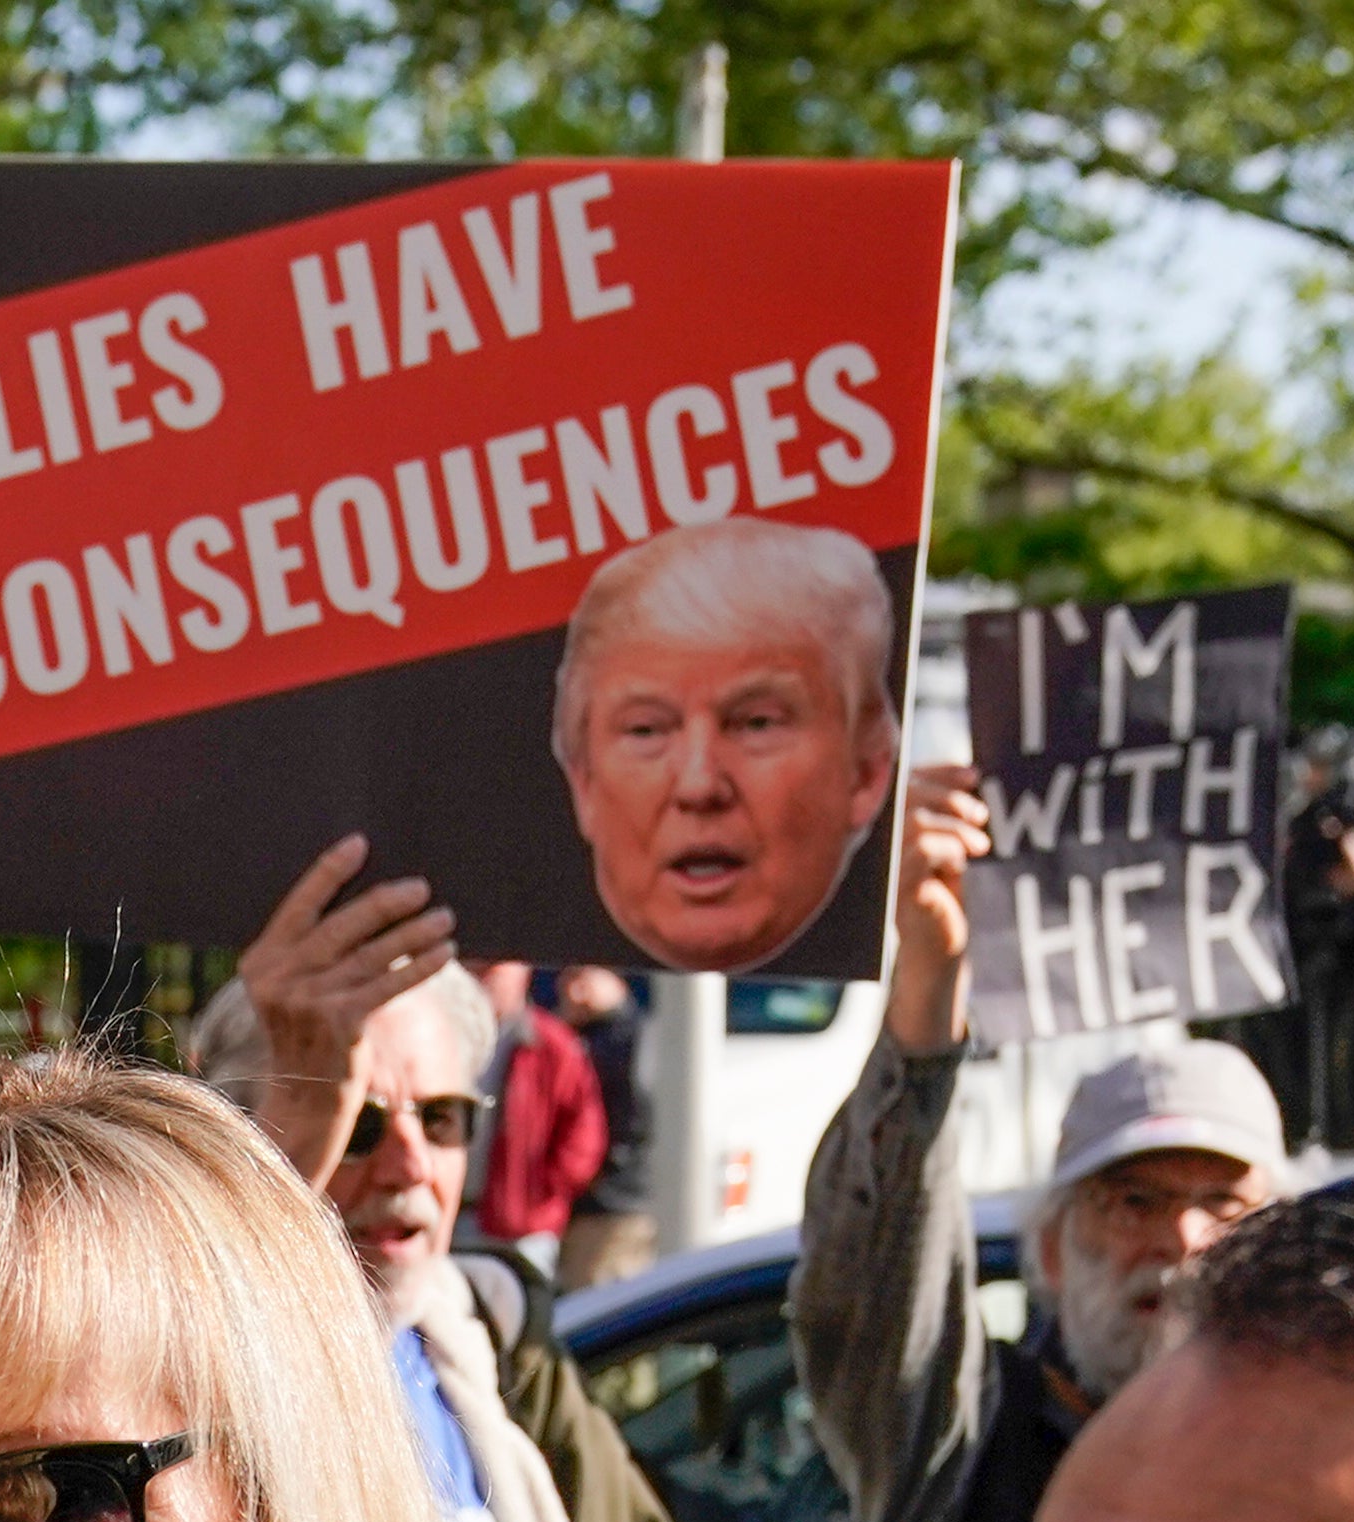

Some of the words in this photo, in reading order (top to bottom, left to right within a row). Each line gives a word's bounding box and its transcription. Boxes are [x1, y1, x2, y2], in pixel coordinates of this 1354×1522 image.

[288, 172, 635, 393] HAVE
[1017, 600, 1199, 756] I'M
[1014, 841, 1286, 1038] HER
